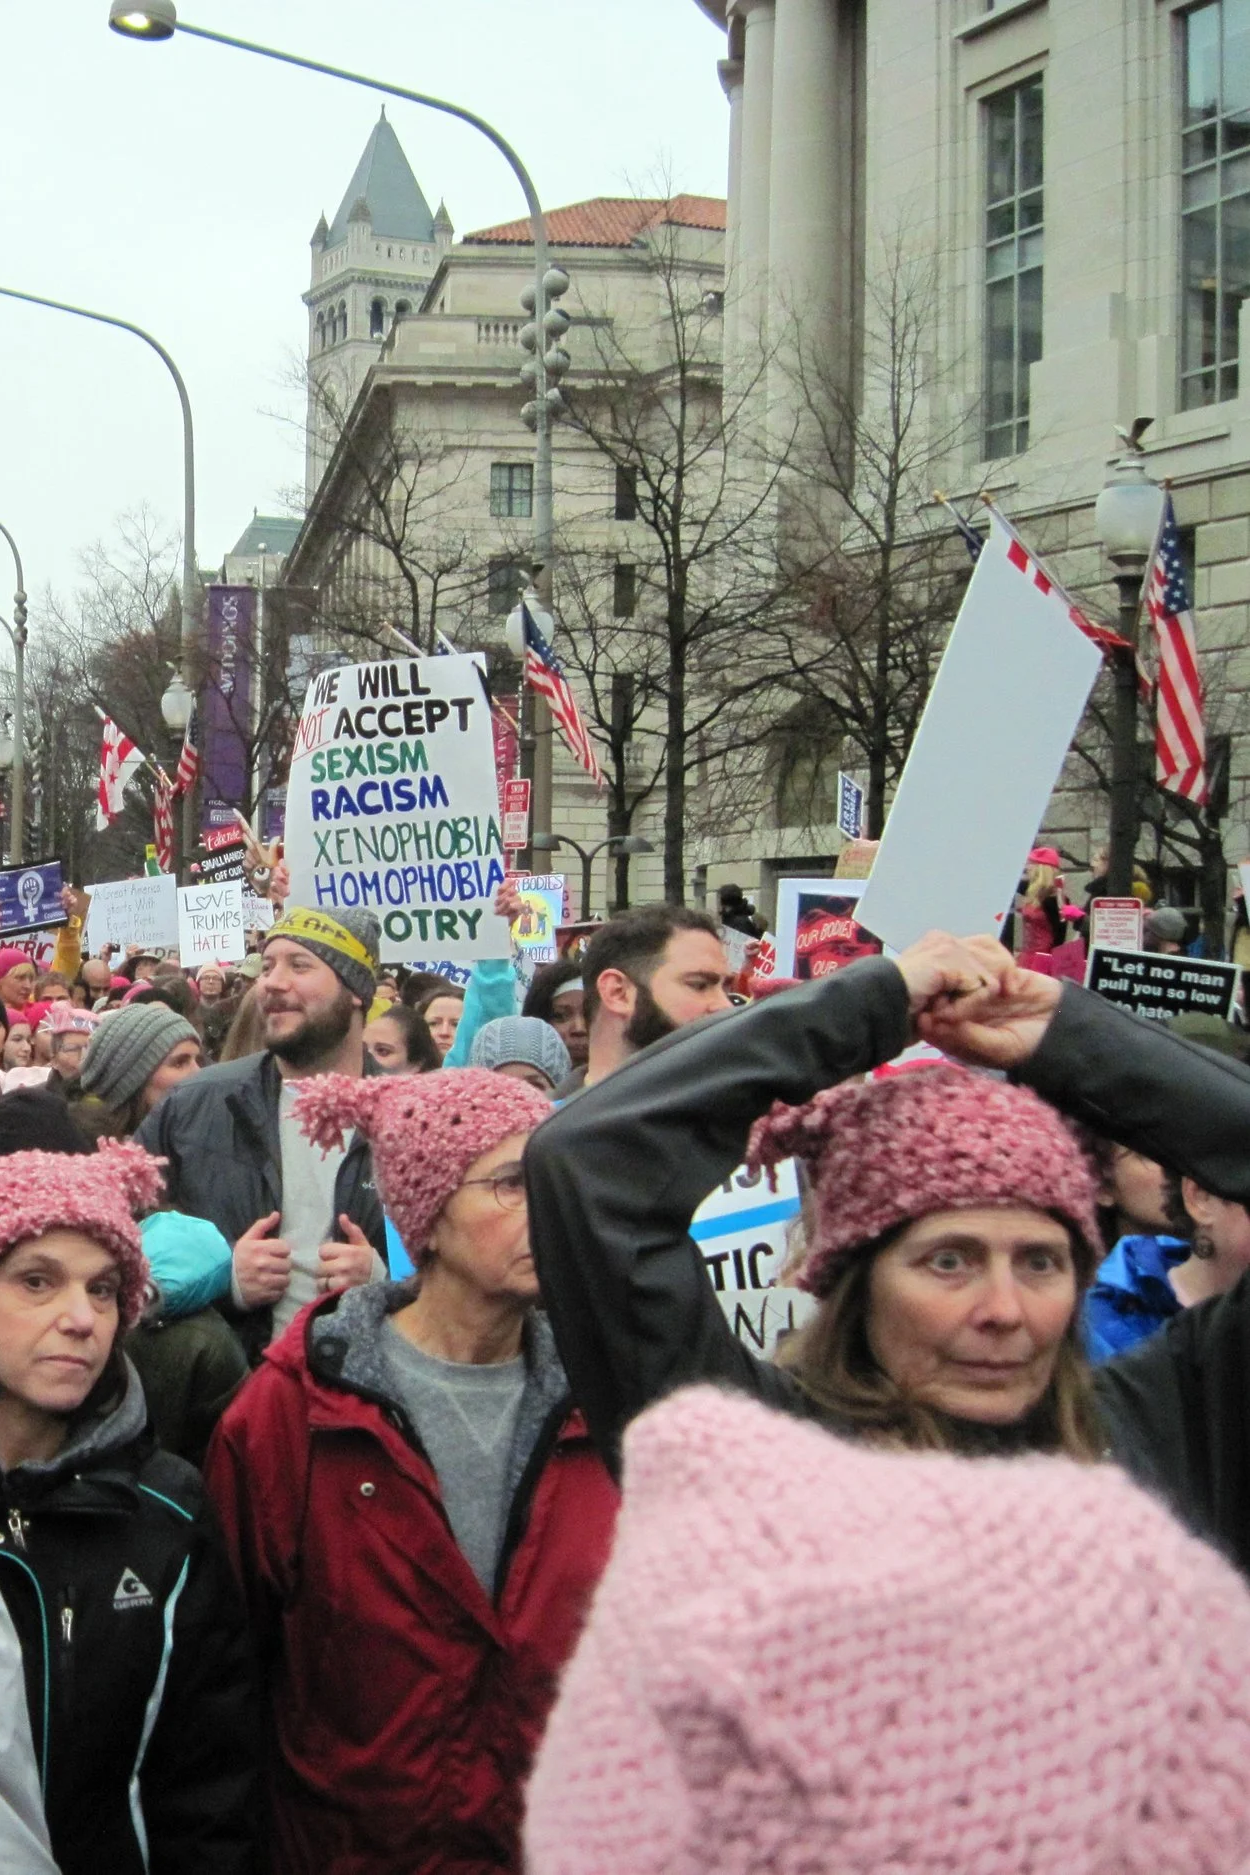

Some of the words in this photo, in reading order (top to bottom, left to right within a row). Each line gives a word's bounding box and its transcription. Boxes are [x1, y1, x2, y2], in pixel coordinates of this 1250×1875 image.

[311, 671, 341, 707] WE
[357, 662, 431, 700] WILL
[294, 708, 332, 756] NOT
[333, 697, 474, 740] ACCEPT
[310, 739, 429, 784] SEXISM
[311, 774, 450, 822] RACISM
[843, 781, 851, 829] TRUST
[314, 815, 502, 868] XENOPHOBIA
[201, 854, 225, 872] SMALL
[215, 871, 227, 881] OFF
[229, 865, 244, 877] OUR
[315, 858, 505, 907] HOMOPHOBIA
[522, 875, 563, 891] BODIES
[190, 911, 241, 930] TRUMPS
[384, 908, 483, 943] OTRY
[797, 932, 819, 949] OUR
[820, 920, 856, 942] BODIES
[193, 934, 230, 952] HATE
[523, 946, 554, 961] HOICE
[1102, 956, 1144, 976] "Let
[1150, 966, 1175, 980] no
[1181, 969, 1225, 987] man
[1098, 977, 1129, 991] pull
[1132, 983, 1163, 996] you
[1166, 987, 1187, 1000] so
[1191, 989, 1222, 1005] low
[1137, 1001, 1174, 1019] hate
